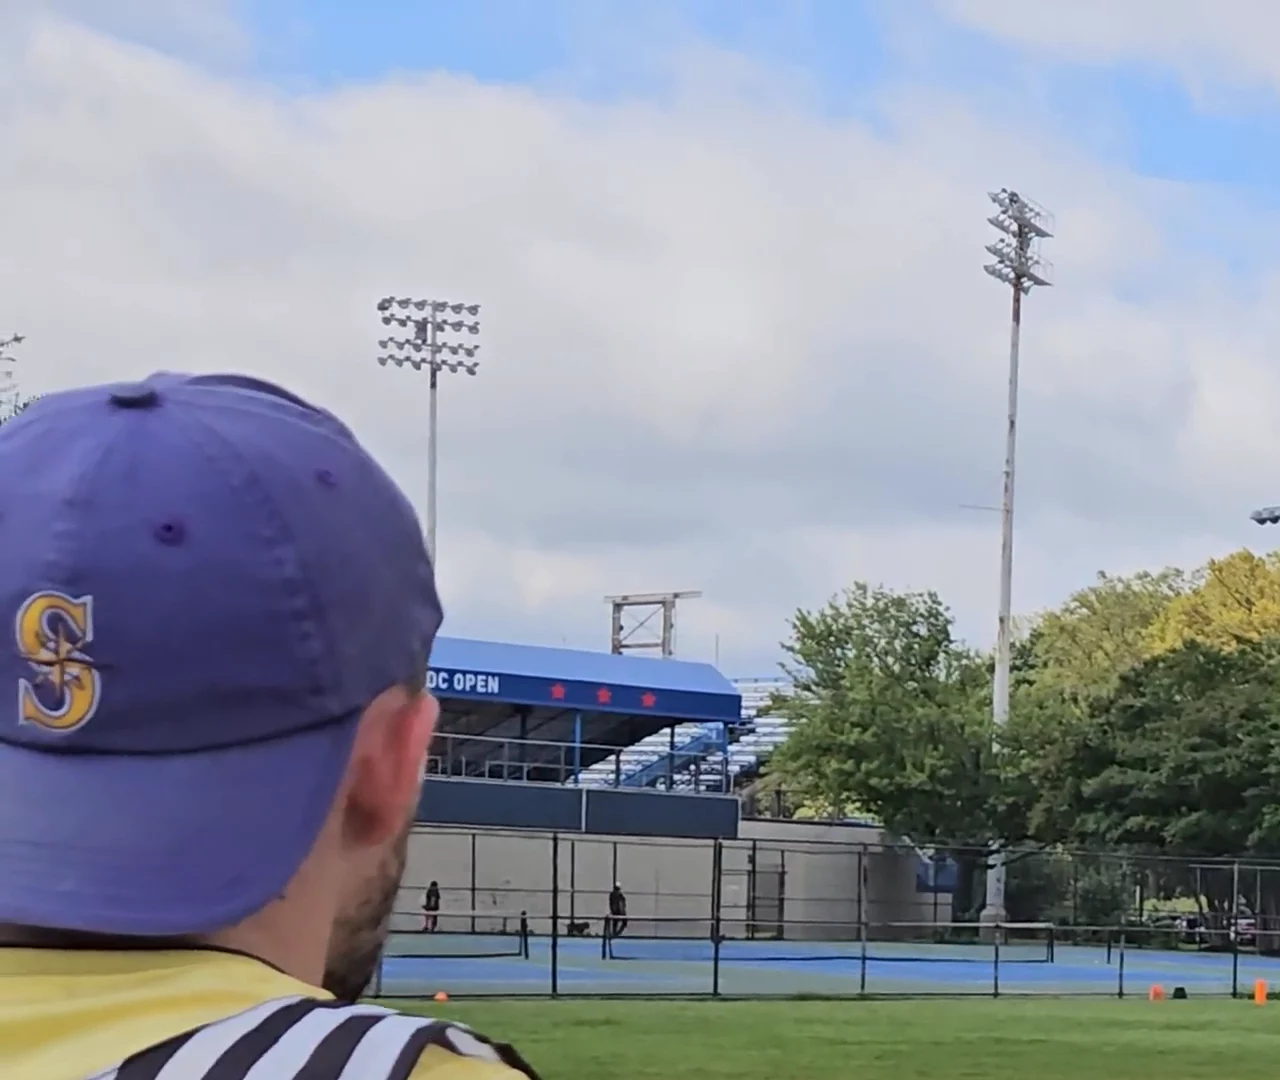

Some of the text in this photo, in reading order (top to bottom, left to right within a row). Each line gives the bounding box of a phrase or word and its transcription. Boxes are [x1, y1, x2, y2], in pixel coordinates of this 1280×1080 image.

[16, 590, 101, 732] S
[426, 671, 500, 694] DC OPEN
